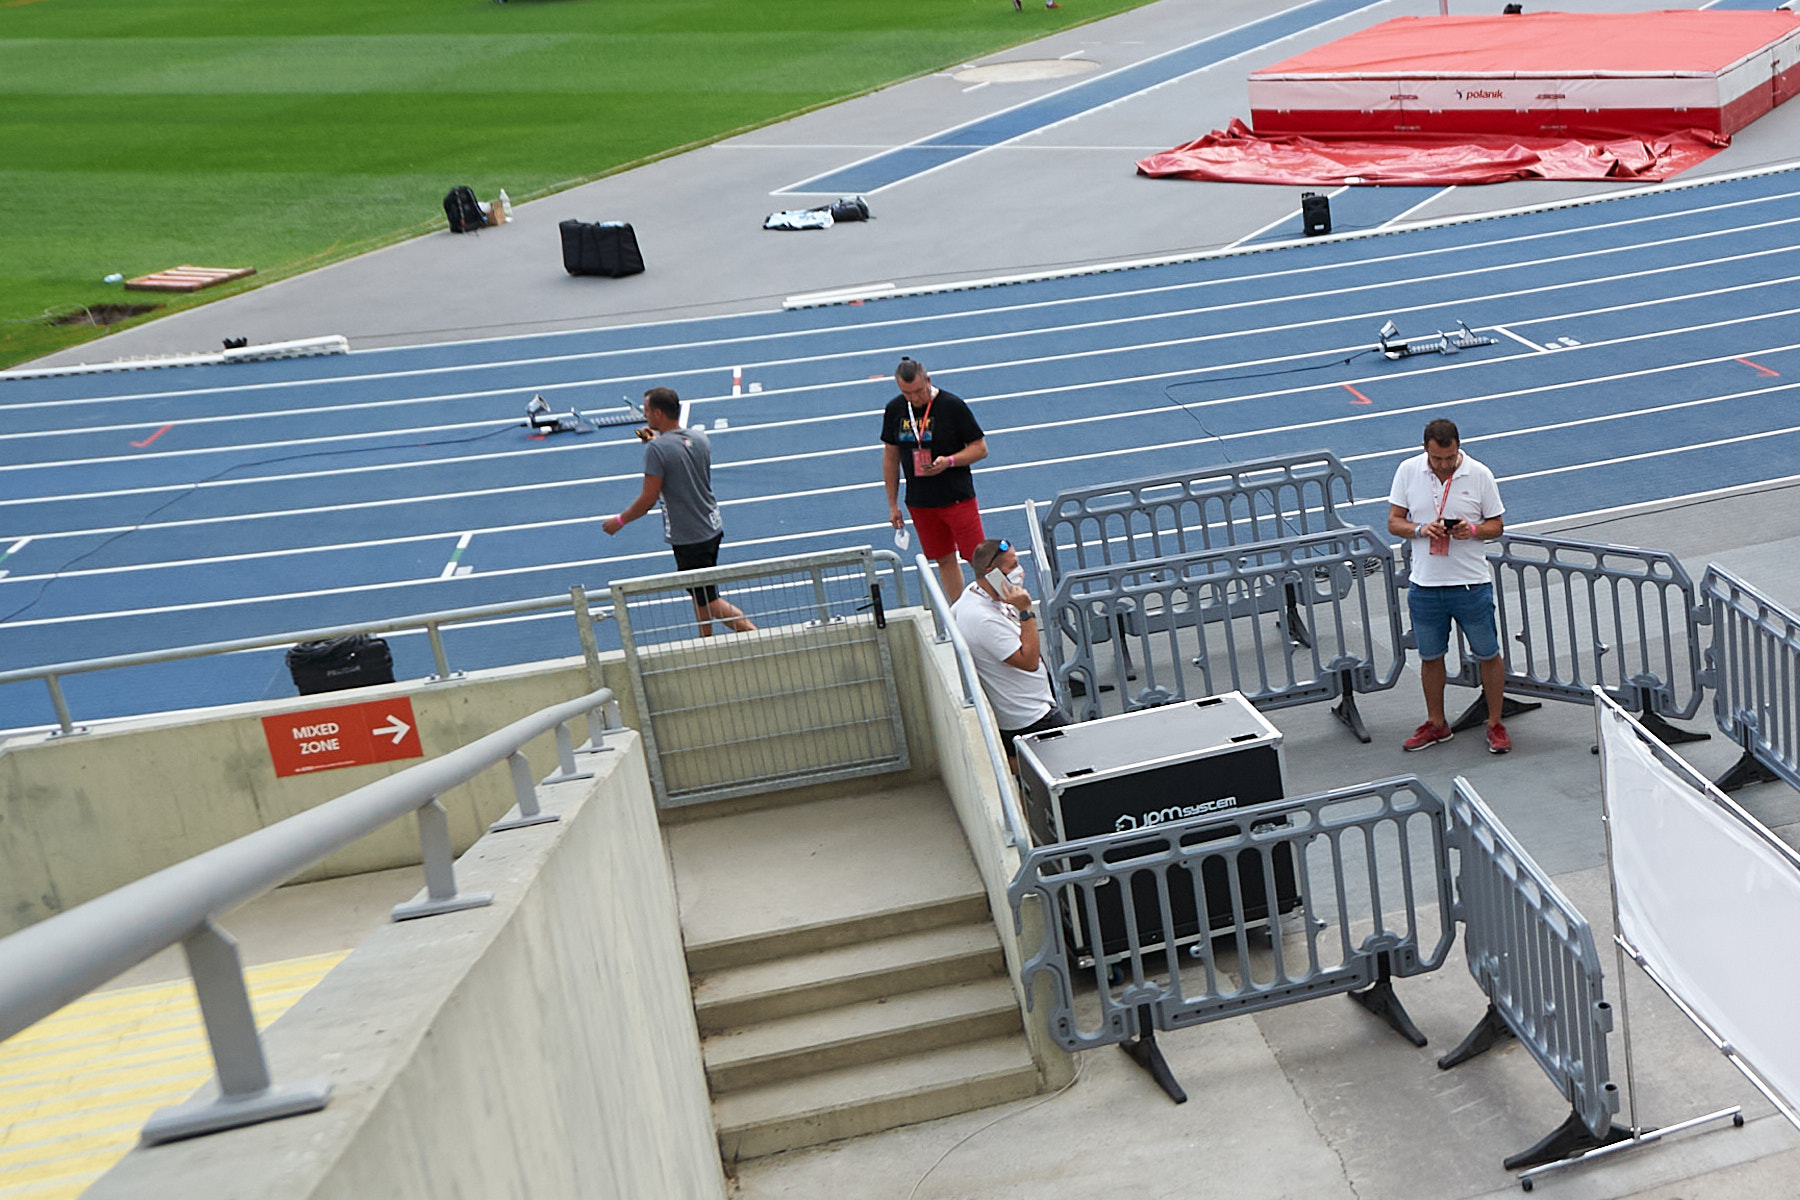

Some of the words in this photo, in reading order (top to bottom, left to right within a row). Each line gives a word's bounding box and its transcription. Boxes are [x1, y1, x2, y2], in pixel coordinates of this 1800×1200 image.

[1466, 89, 1503, 101] polanik
[292, 722, 340, 739] MIXED
[299, 738, 340, 755] ZONE
